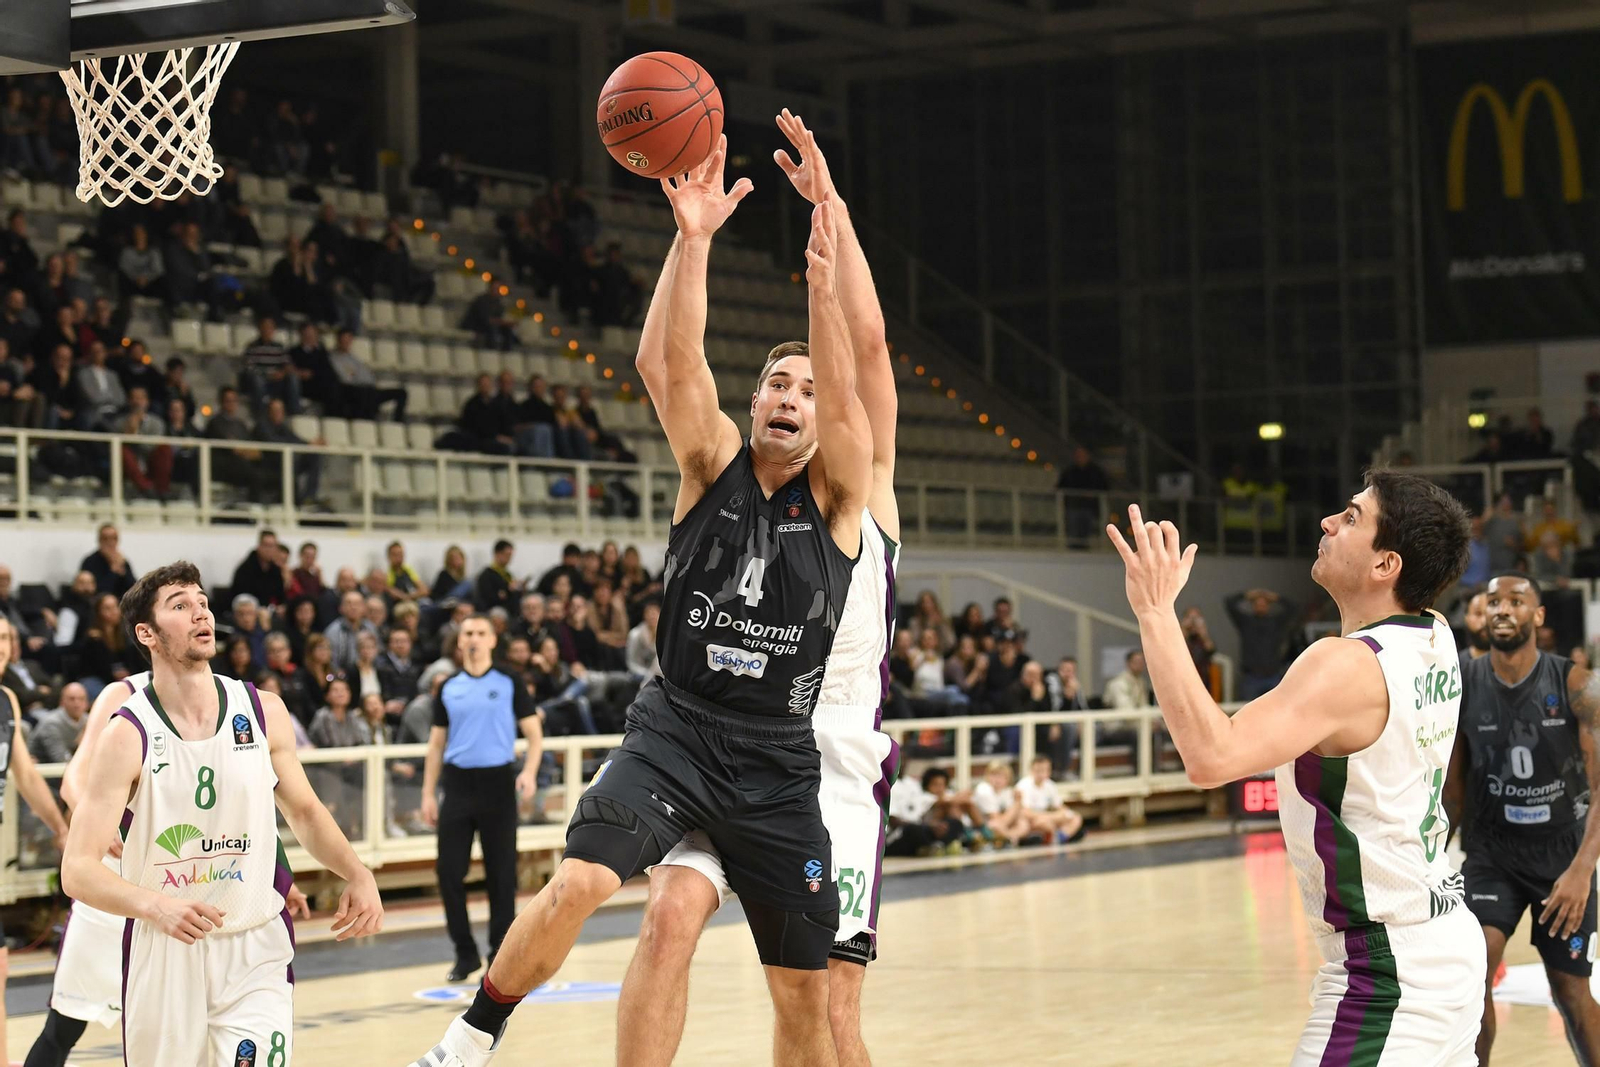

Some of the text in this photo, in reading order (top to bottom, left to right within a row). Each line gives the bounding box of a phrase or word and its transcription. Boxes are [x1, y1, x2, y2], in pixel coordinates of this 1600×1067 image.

[778, 522, 812, 533] oneteam
[737, 557, 765, 607] 4
[714, 611, 805, 642] Dolomiti
[742, 638, 798, 656] energia
[233, 743, 259, 752] oneteam
[1511, 745, 1534, 779] 0
[195, 766, 216, 810] 8
[160, 860, 244, 891] Andalucía
[838, 867, 866, 919] 52
